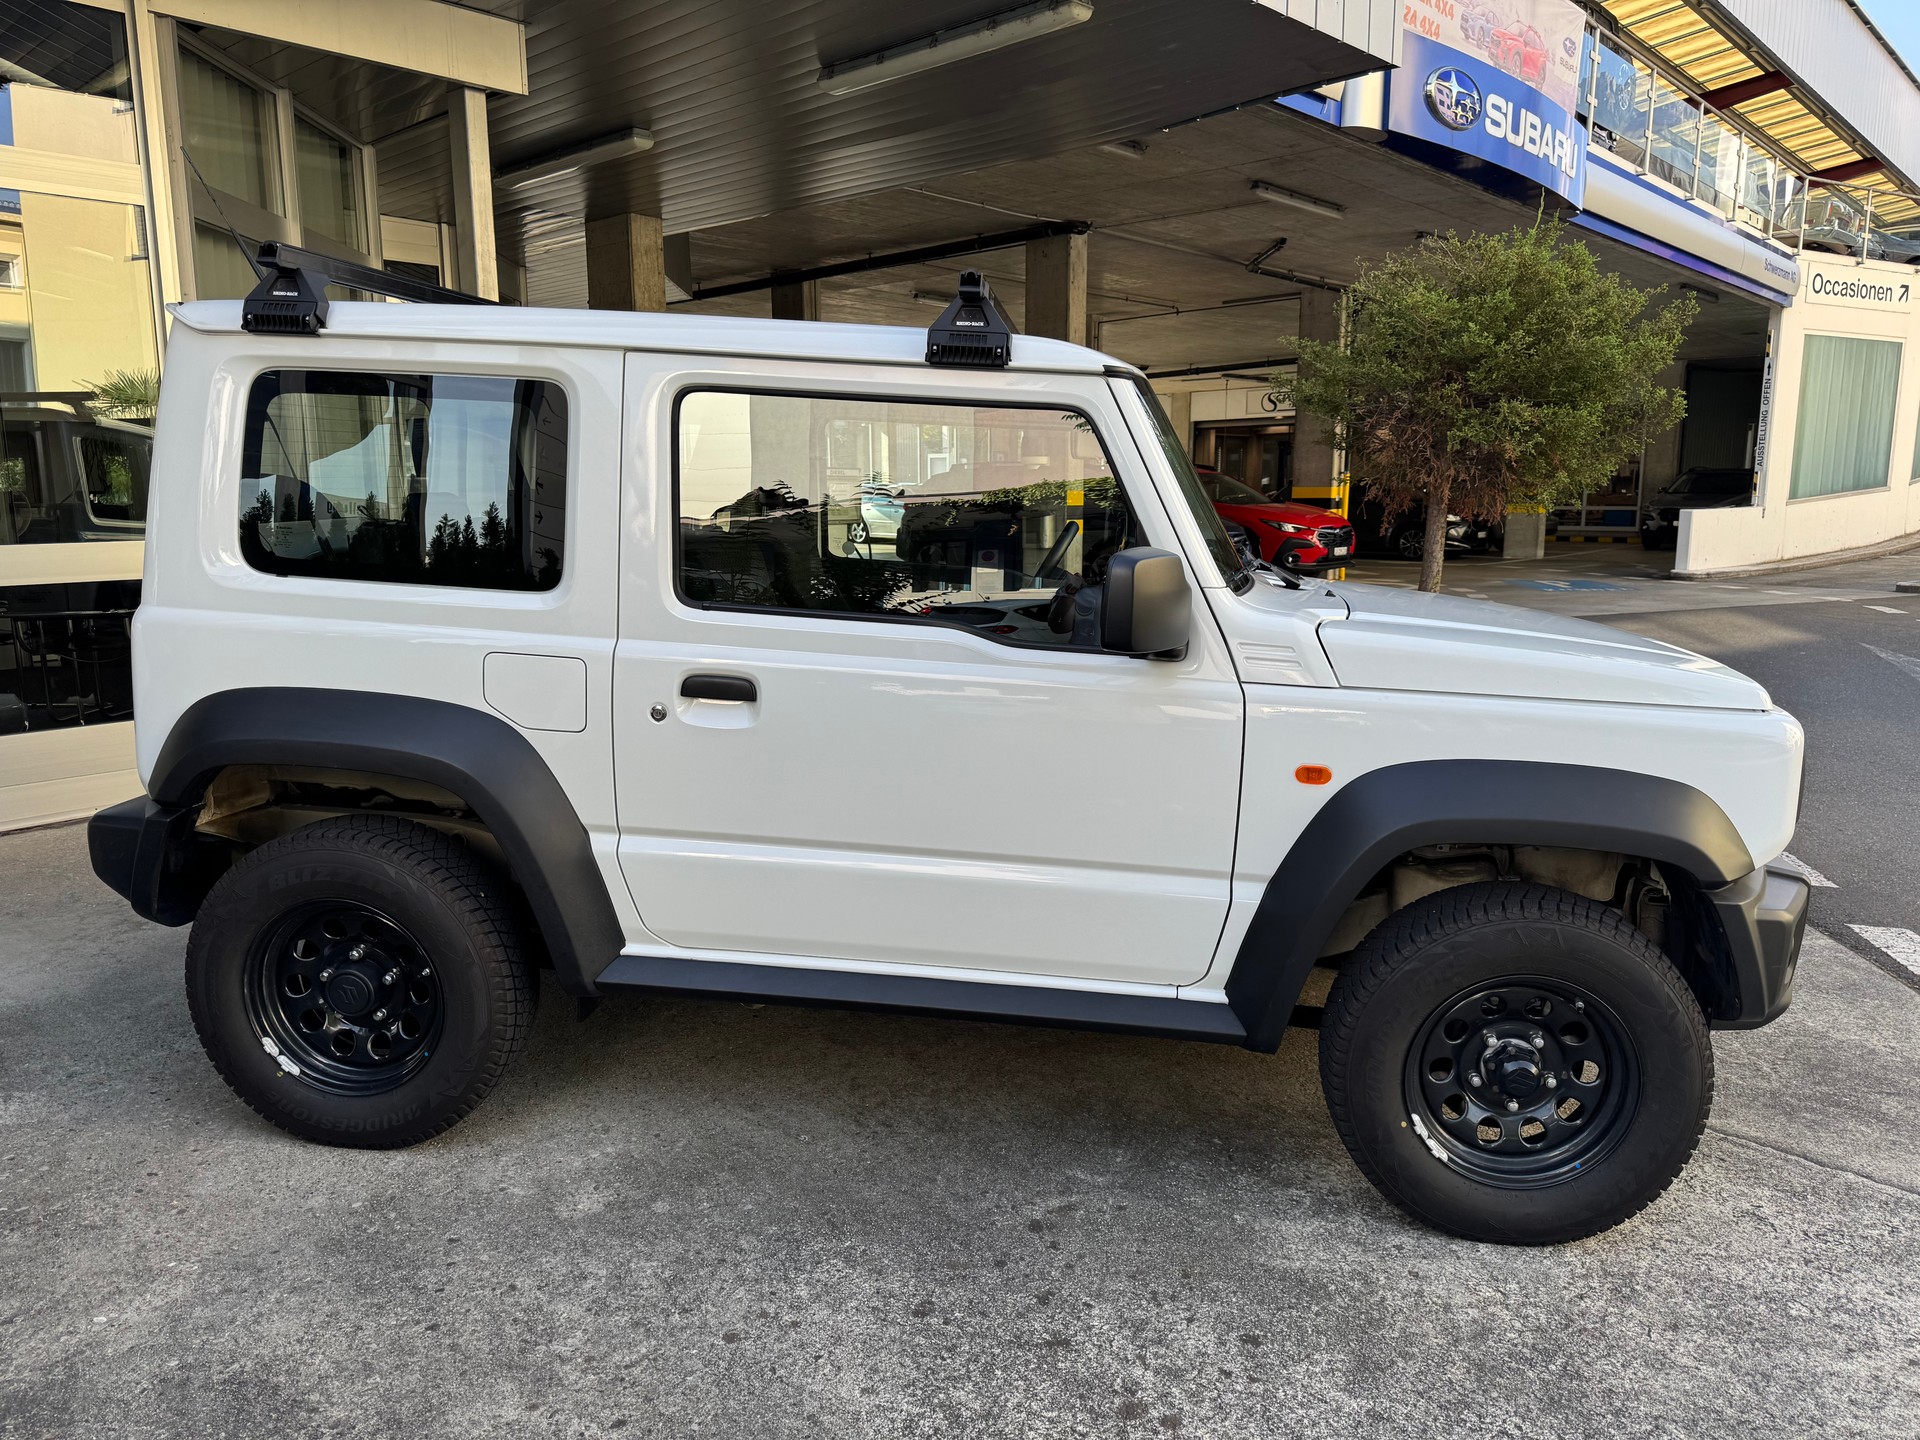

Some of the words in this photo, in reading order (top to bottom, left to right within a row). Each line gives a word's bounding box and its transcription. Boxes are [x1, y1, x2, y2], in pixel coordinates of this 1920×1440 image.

[1484, 94, 1578, 179] SUBARU
[1812, 273, 1893, 302] Occasionen
[1762, 378, 1772, 406] OFFEN
[1756, 409, 1769, 467] AUSSTELLUNG
